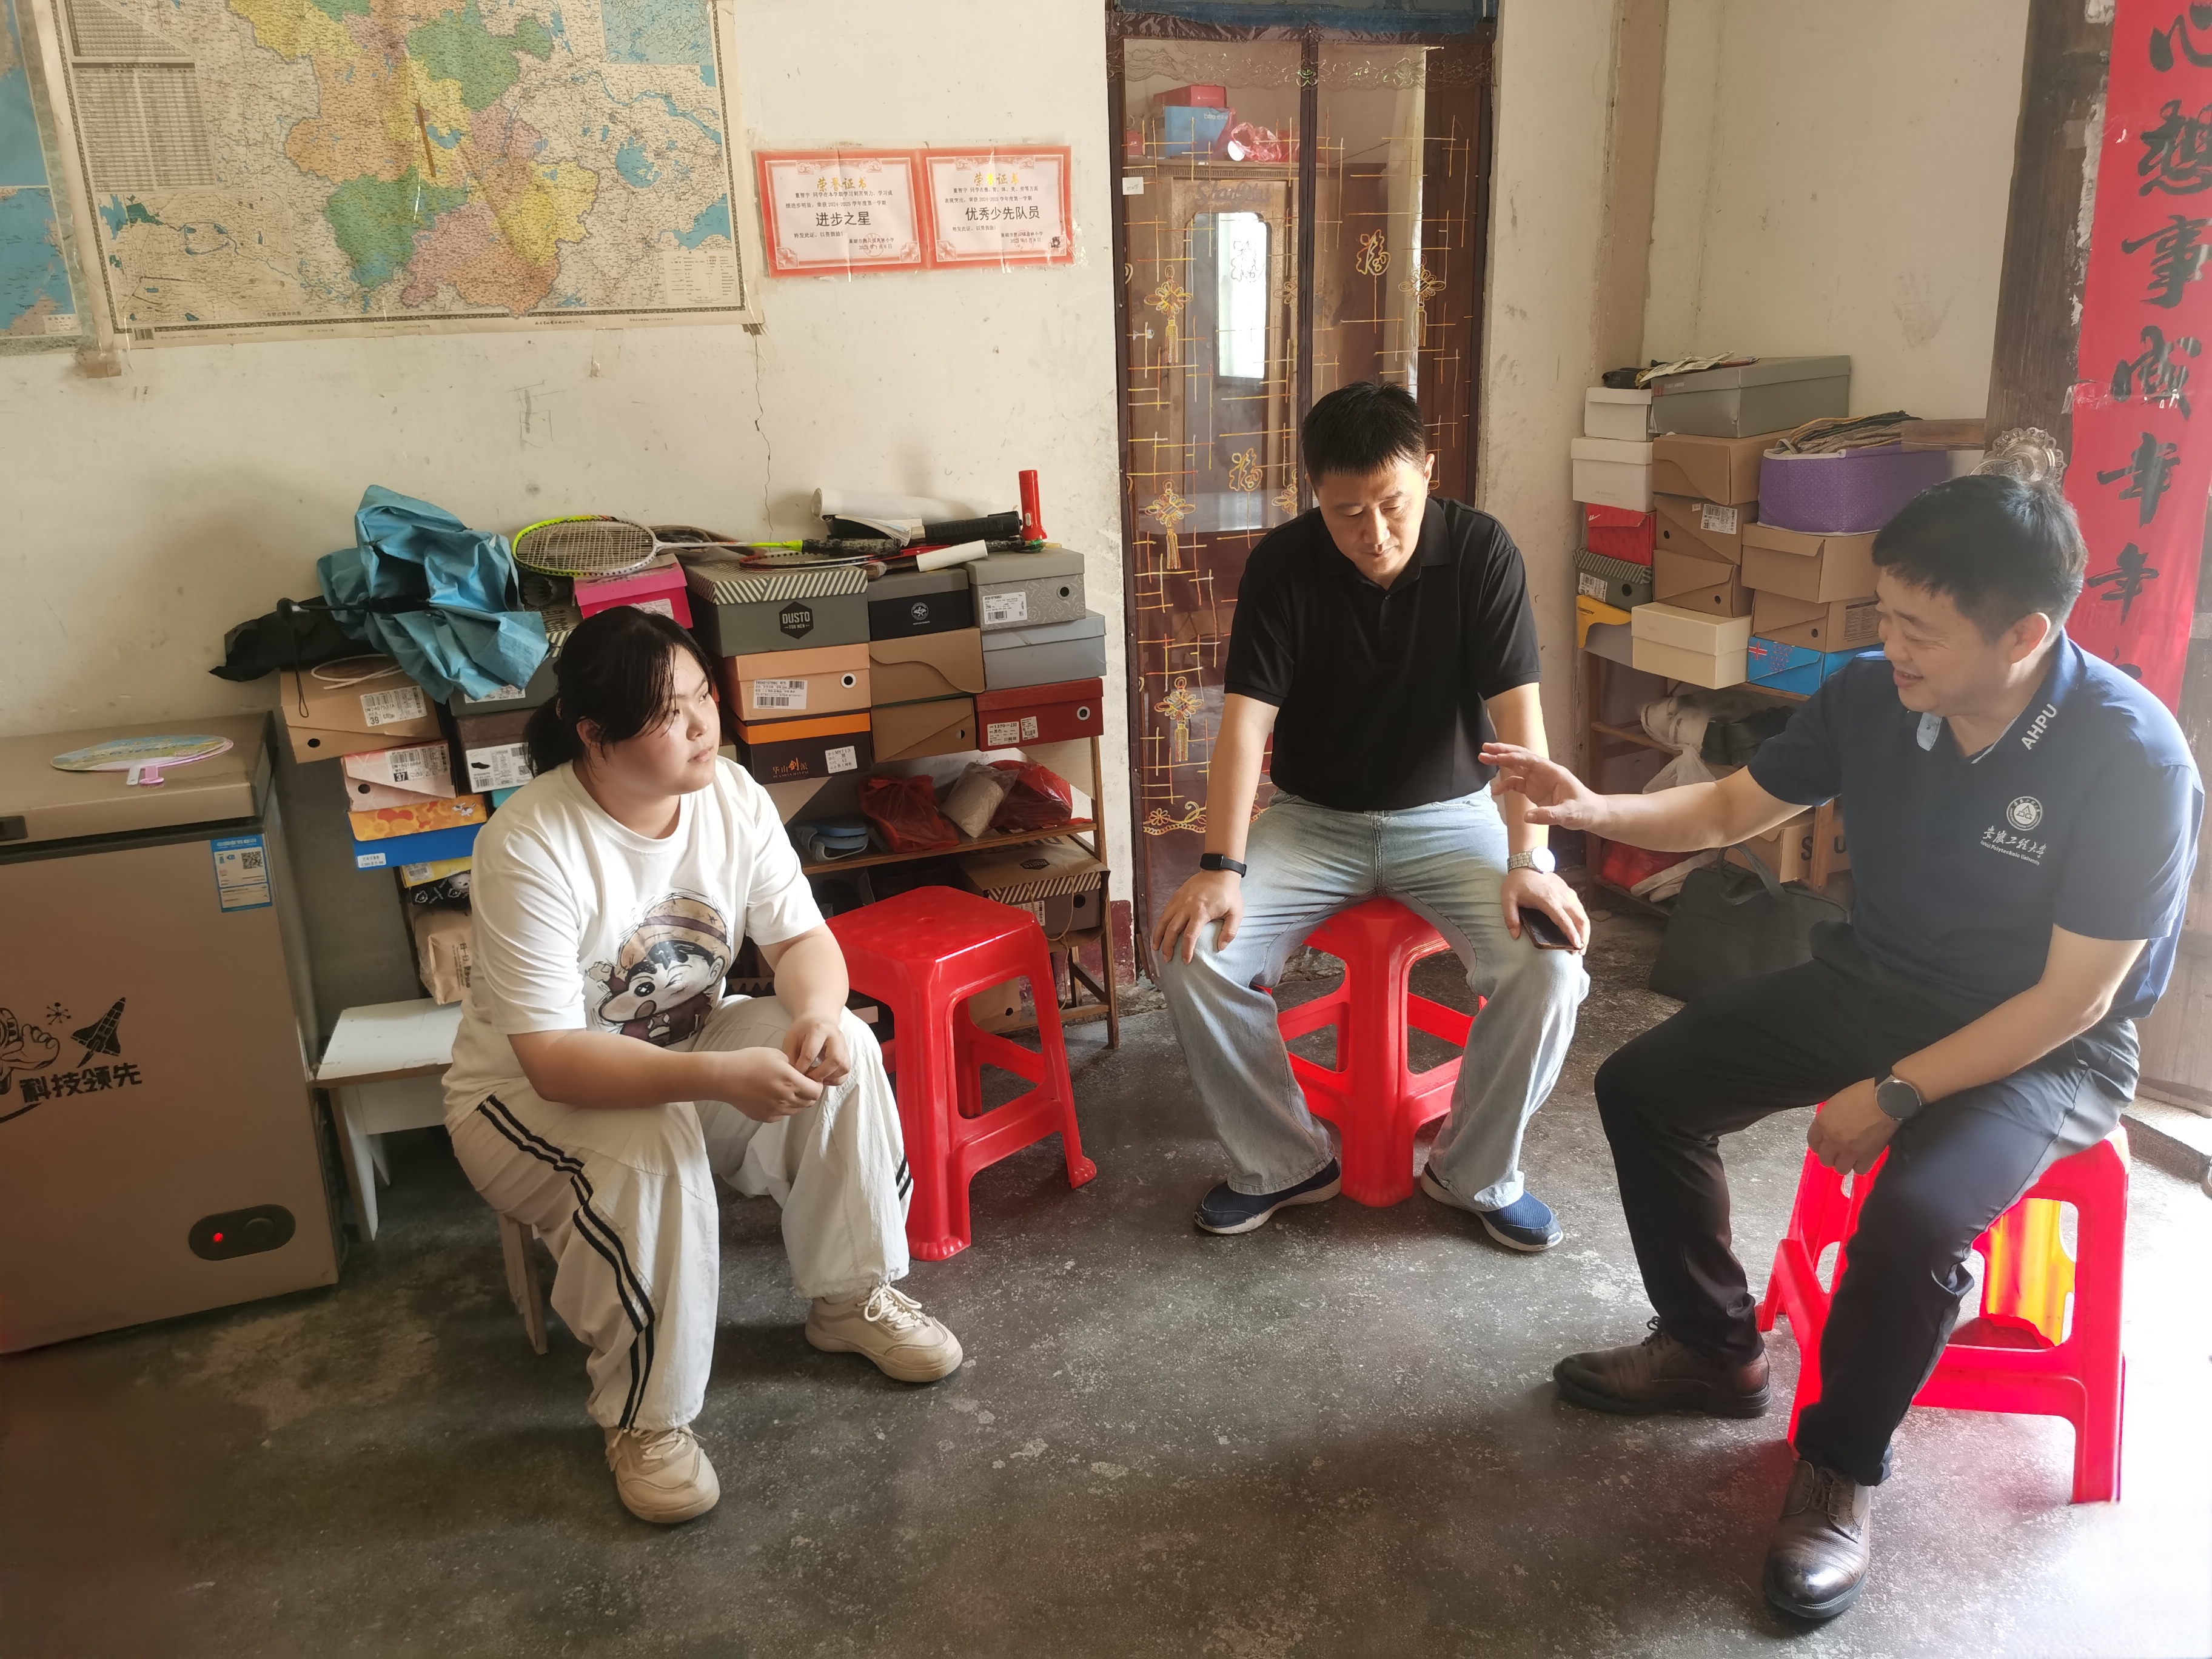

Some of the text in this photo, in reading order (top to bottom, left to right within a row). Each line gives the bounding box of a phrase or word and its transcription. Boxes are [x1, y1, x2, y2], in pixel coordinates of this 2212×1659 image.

[817, 176, 868, 192] 荣誉证书
[974, 172, 1019, 186] 荣誉证书
[816, 211, 871, 226] 进步之星
[965, 206, 1041, 221] 优秀少先队员
[1228, 447, 1263, 492] 福
[782, 611, 810, 625] DUSTO
[370, 716, 380, 725] 39
[2021, 703, 2058, 750] AHPU
[1982, 825, 2047, 859] 安徽工程大学
[19, 1062, 142, 1104] 科技领先
